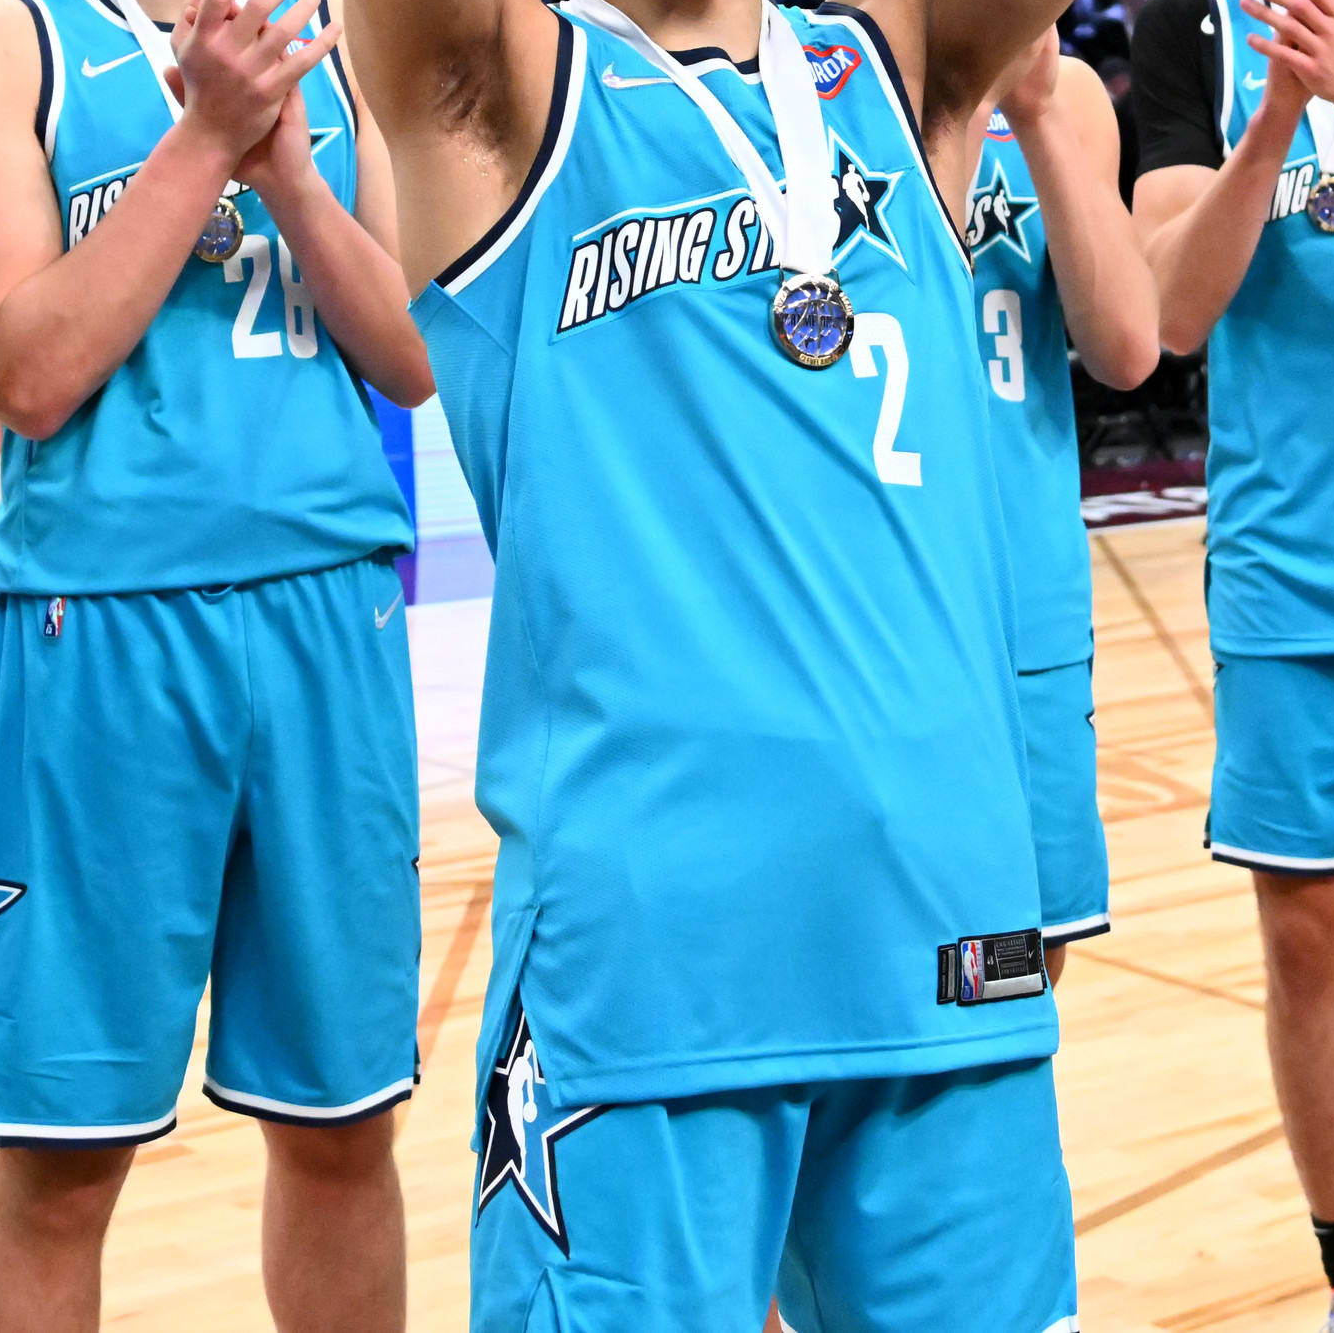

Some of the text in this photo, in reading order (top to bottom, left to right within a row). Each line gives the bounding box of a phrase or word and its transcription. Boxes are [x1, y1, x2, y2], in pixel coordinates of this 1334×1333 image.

[811, 48, 854, 84] ROX
[223, 234, 318, 359] 28
[559, 209, 717, 331] RISING
[851, 313, 922, 486] 2
[983, 288, 1026, 402] 3
